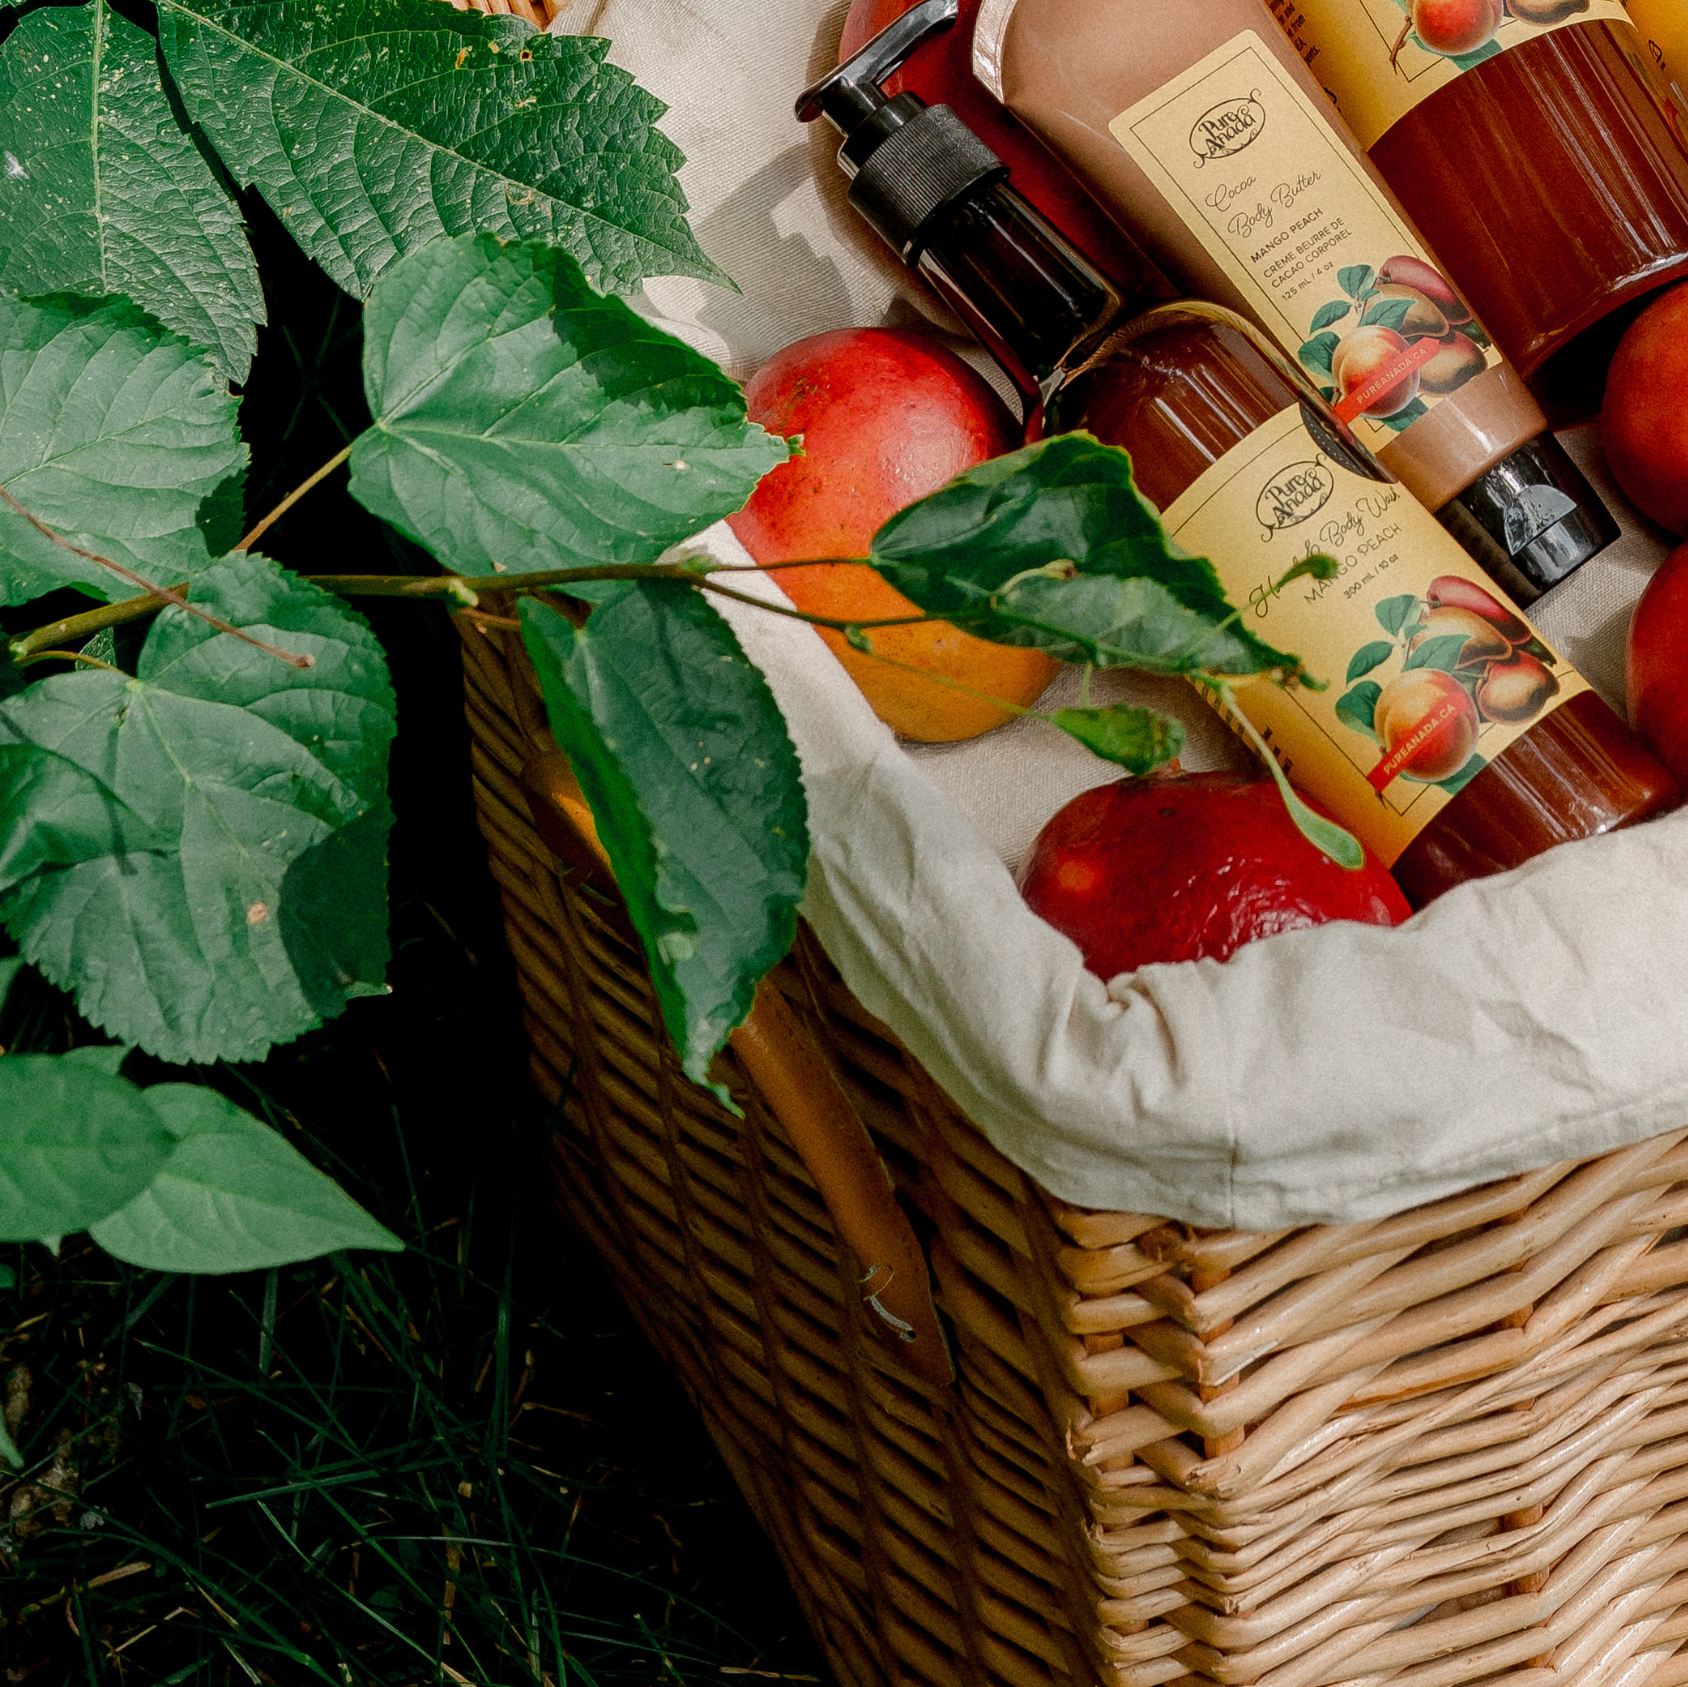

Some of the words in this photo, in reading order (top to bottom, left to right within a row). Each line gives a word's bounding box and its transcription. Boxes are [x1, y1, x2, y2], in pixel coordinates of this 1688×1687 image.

[1198, 111, 1239, 139] Pure
[1204, 109, 1257, 156] Anada
[1204, 175, 1257, 212] Cocoa
[1227, 202, 1274, 238] Body
[1269, 171, 1322, 208] Butter
[1250, 230, 1290, 264] MANGO
[1290, 207, 1324, 235] PEACH
[1263, 251, 1296, 278] CRÈME
[1296, 226, 1331, 255] BEURRE
[1331, 217, 1345, 232] DE
[1271, 261, 1305, 289] CACAO
[1305, 228, 1353, 264] CORPOREL
[1281, 286, 1298, 301] 125
[1298, 277, 1312, 289] mL
[1316, 268, 1323, 276] 4
[1324, 261, 1335, 271] oz
[1265, 474, 1306, 505] Pure
[1272, 470, 1325, 527] Anada
[1319, 511, 1363, 547] Body
[1355, 486, 1400, 518] Wash
[1357, 522, 1402, 556] PEACH
[1344, 581, 1362, 599] 300
[1361, 572, 1375, 585] mL
[1379, 560, 1389, 571] 10
[1388, 554, 1399, 563] oz
